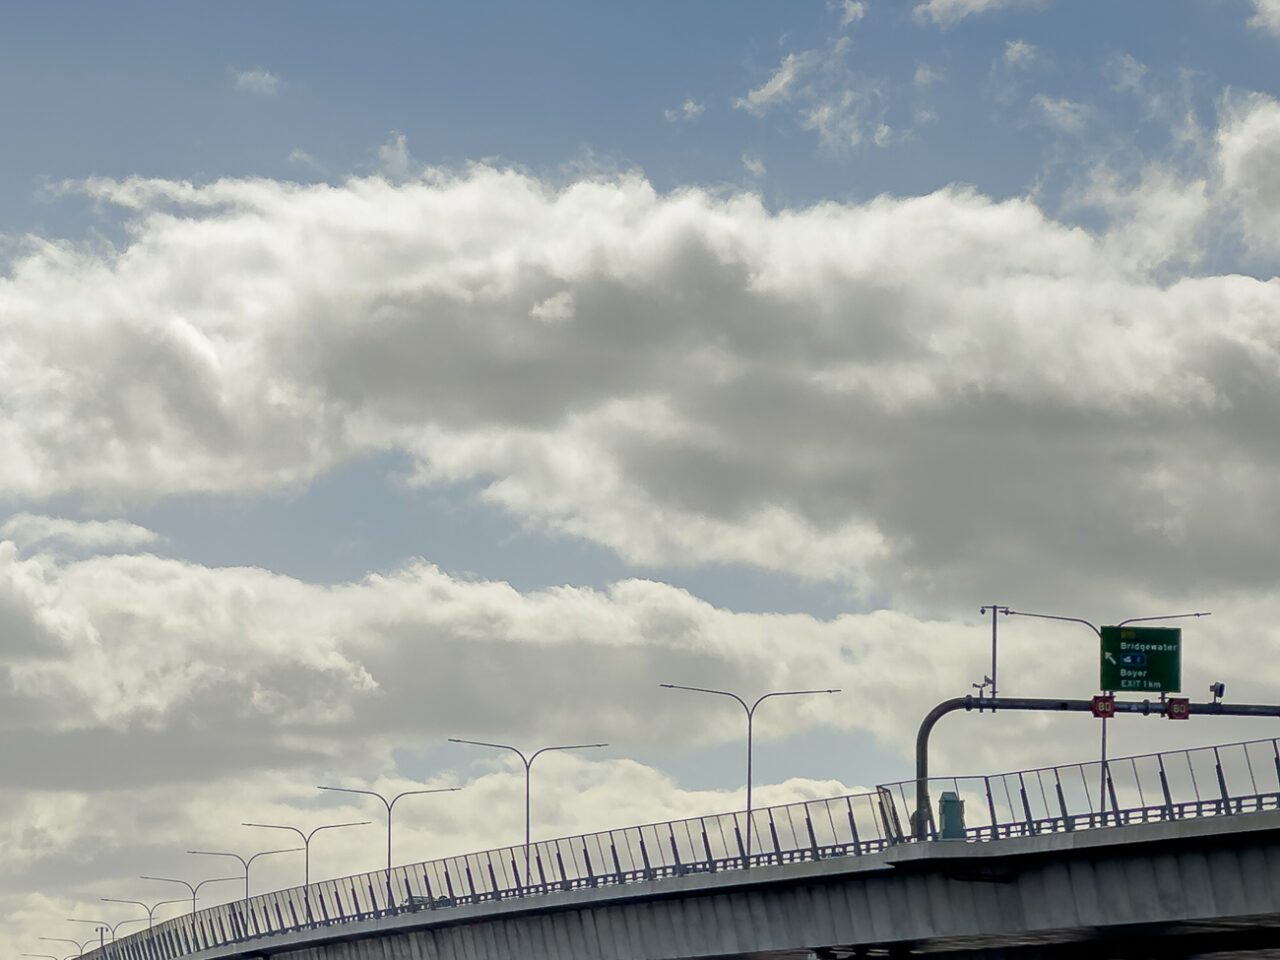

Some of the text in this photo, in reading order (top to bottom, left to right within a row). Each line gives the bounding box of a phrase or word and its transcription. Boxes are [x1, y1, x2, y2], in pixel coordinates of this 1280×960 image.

[1120, 642, 1177, 652] Bridgewater
[1120, 668, 1148, 678] Boyer
[1121, 679, 1141, 688] EXIT
[1098, 702, 1111, 711] 80
[1173, 704, 1186, 713] 80
